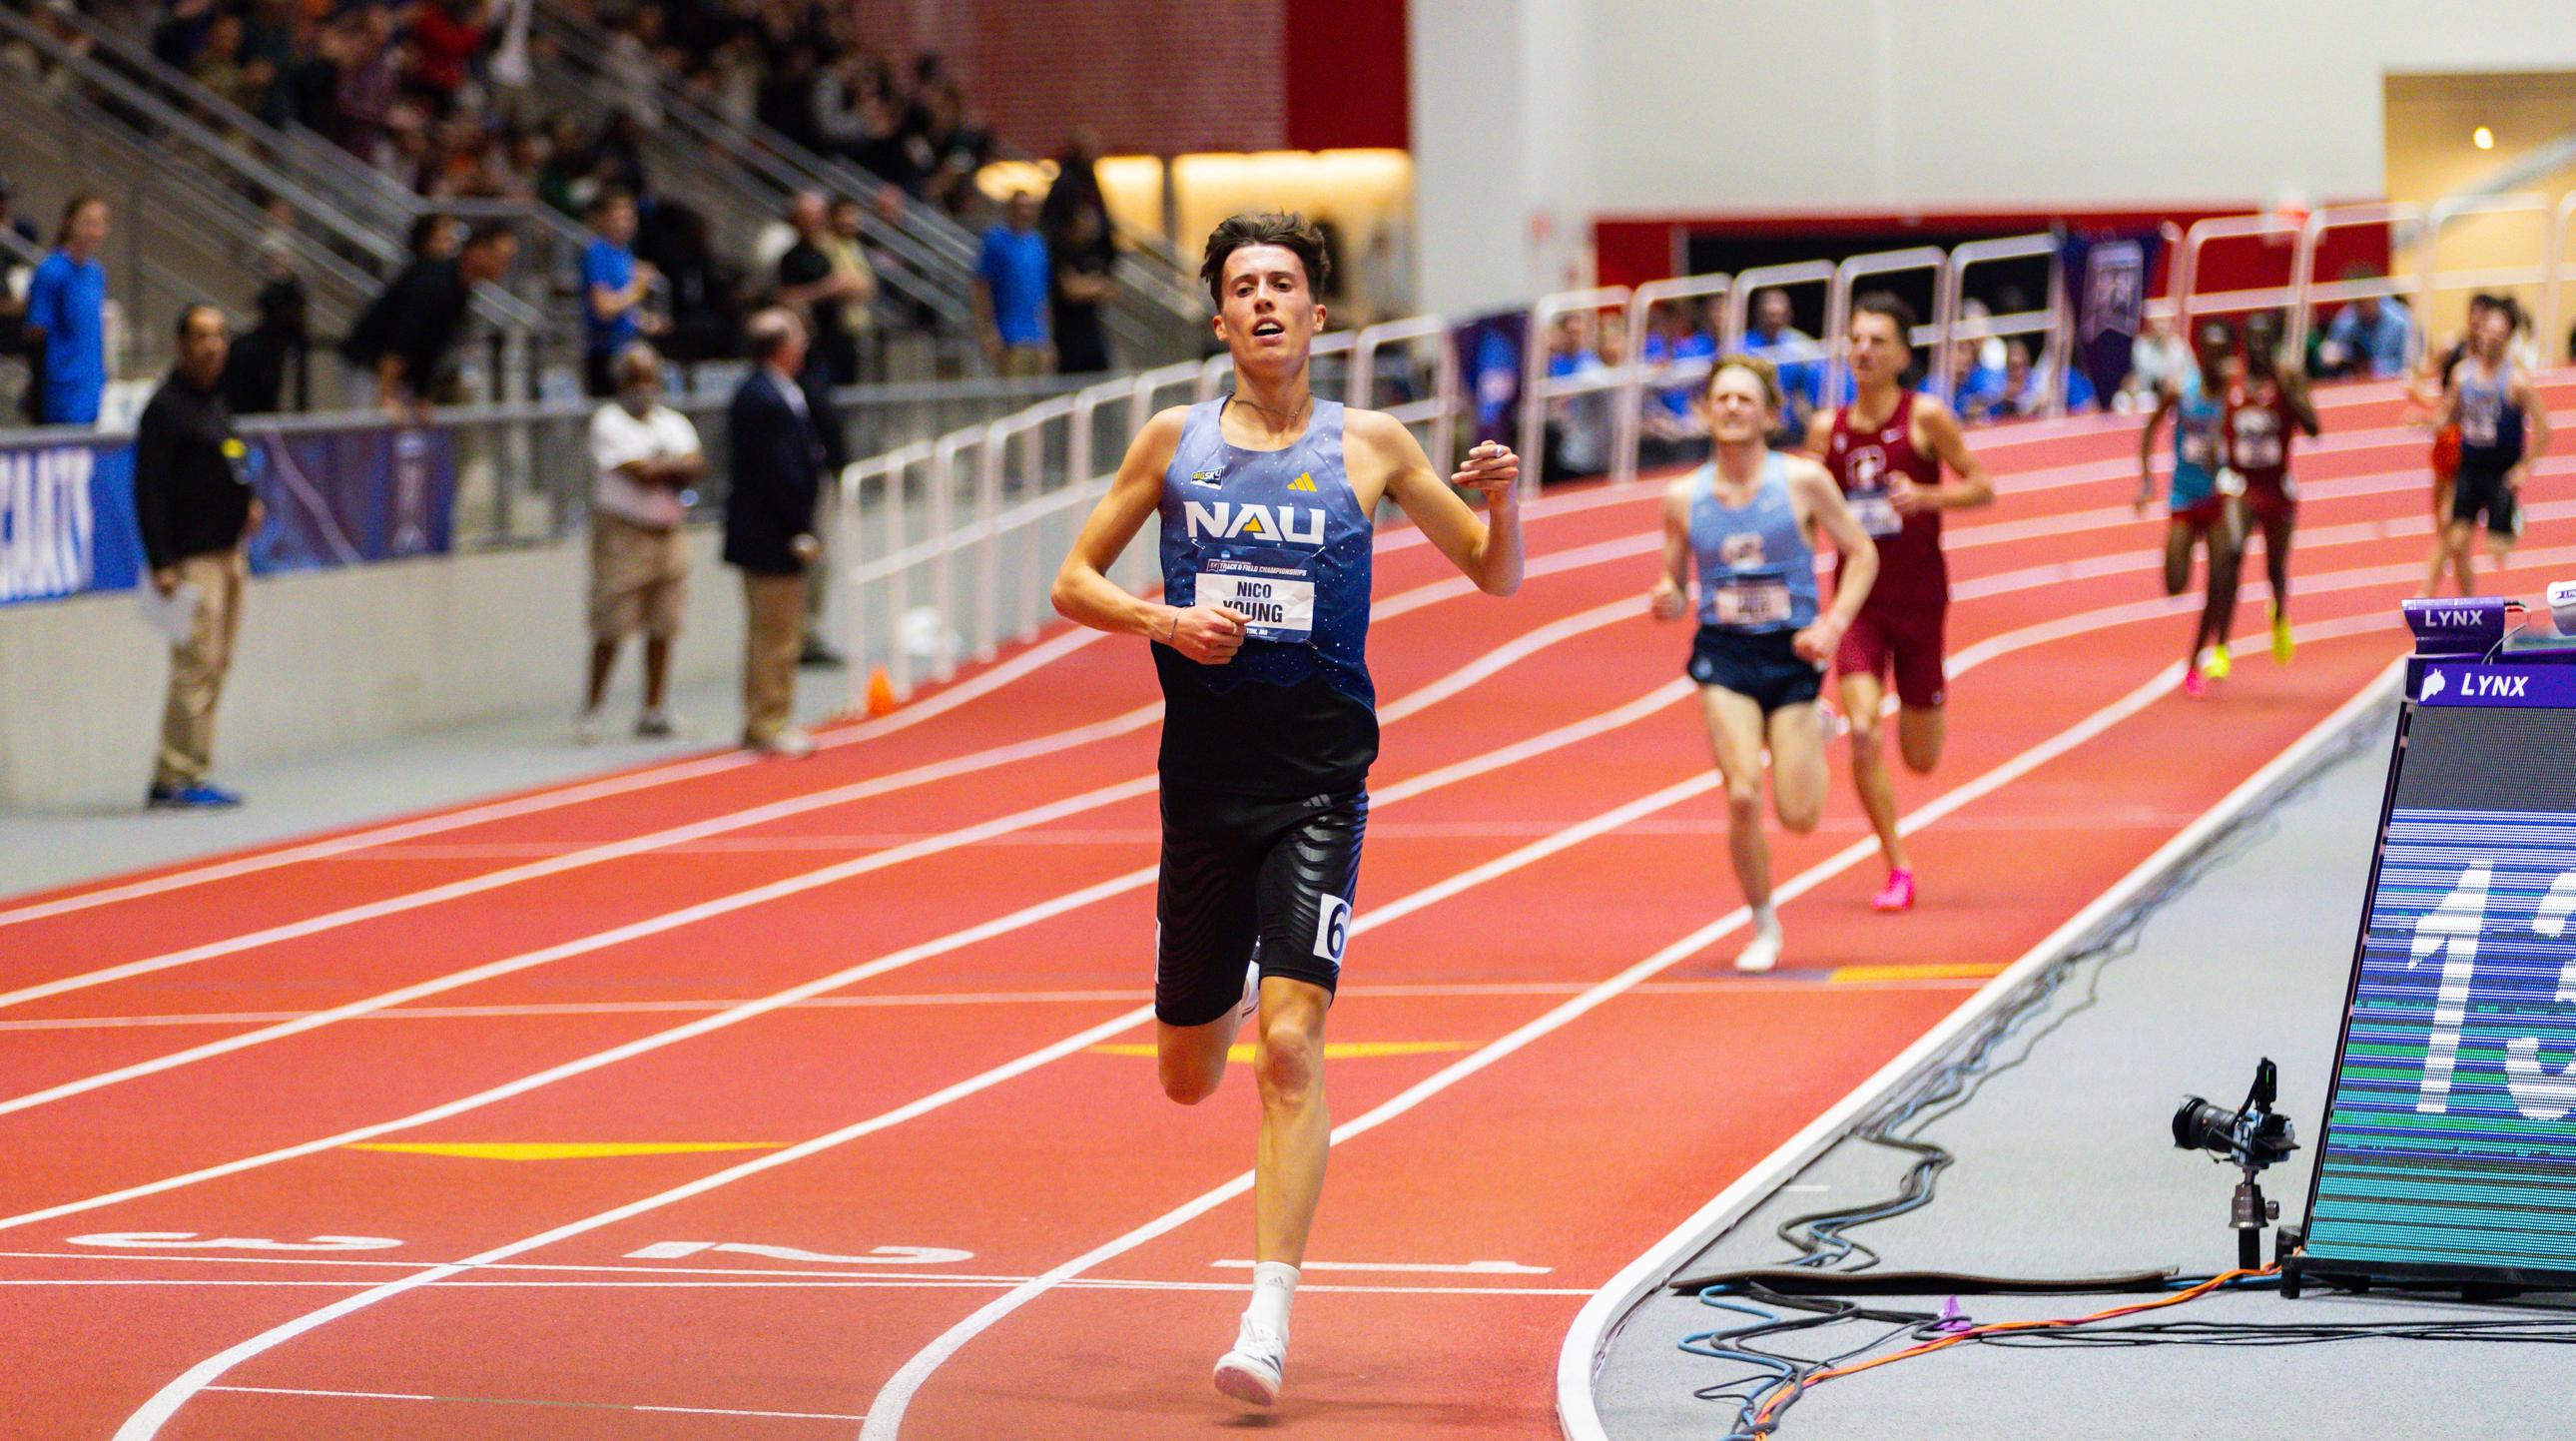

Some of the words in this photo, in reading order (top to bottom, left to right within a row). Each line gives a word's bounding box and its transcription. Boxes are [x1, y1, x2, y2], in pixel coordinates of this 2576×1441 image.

[1183, 501, 1326, 545] NAU
[1259, 565, 1307, 576] CHAMPIONSHIPS
[1236, 581, 1272, 598] NICO
[2424, 609, 2483, 627] LYNX
[2460, 672, 2529, 697] LYNX
[1326, 903, 1348, 960] 6
